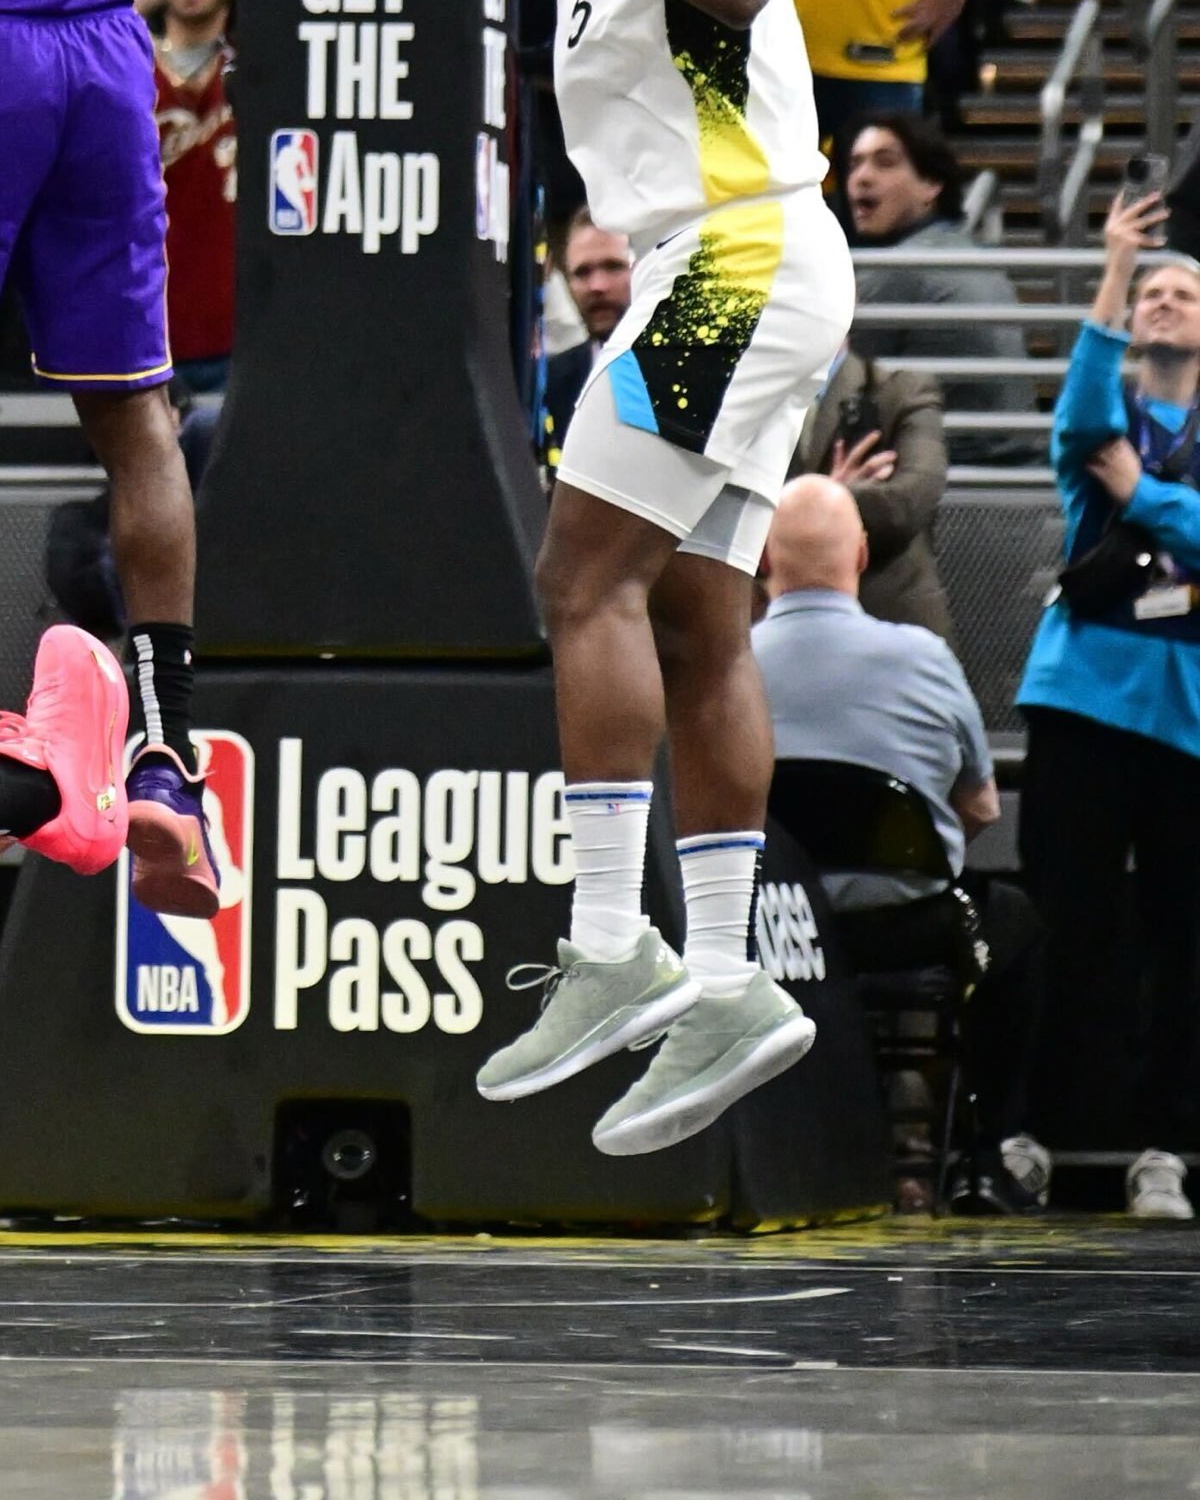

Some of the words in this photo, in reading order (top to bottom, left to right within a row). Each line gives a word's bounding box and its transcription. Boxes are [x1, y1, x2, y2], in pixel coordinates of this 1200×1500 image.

[298, 22, 415, 120] THE
[322, 131, 440, 254] App
[277, 738, 577, 911] League
[137, 965, 200, 1013] NBA
[274, 888, 485, 1034] Pass
